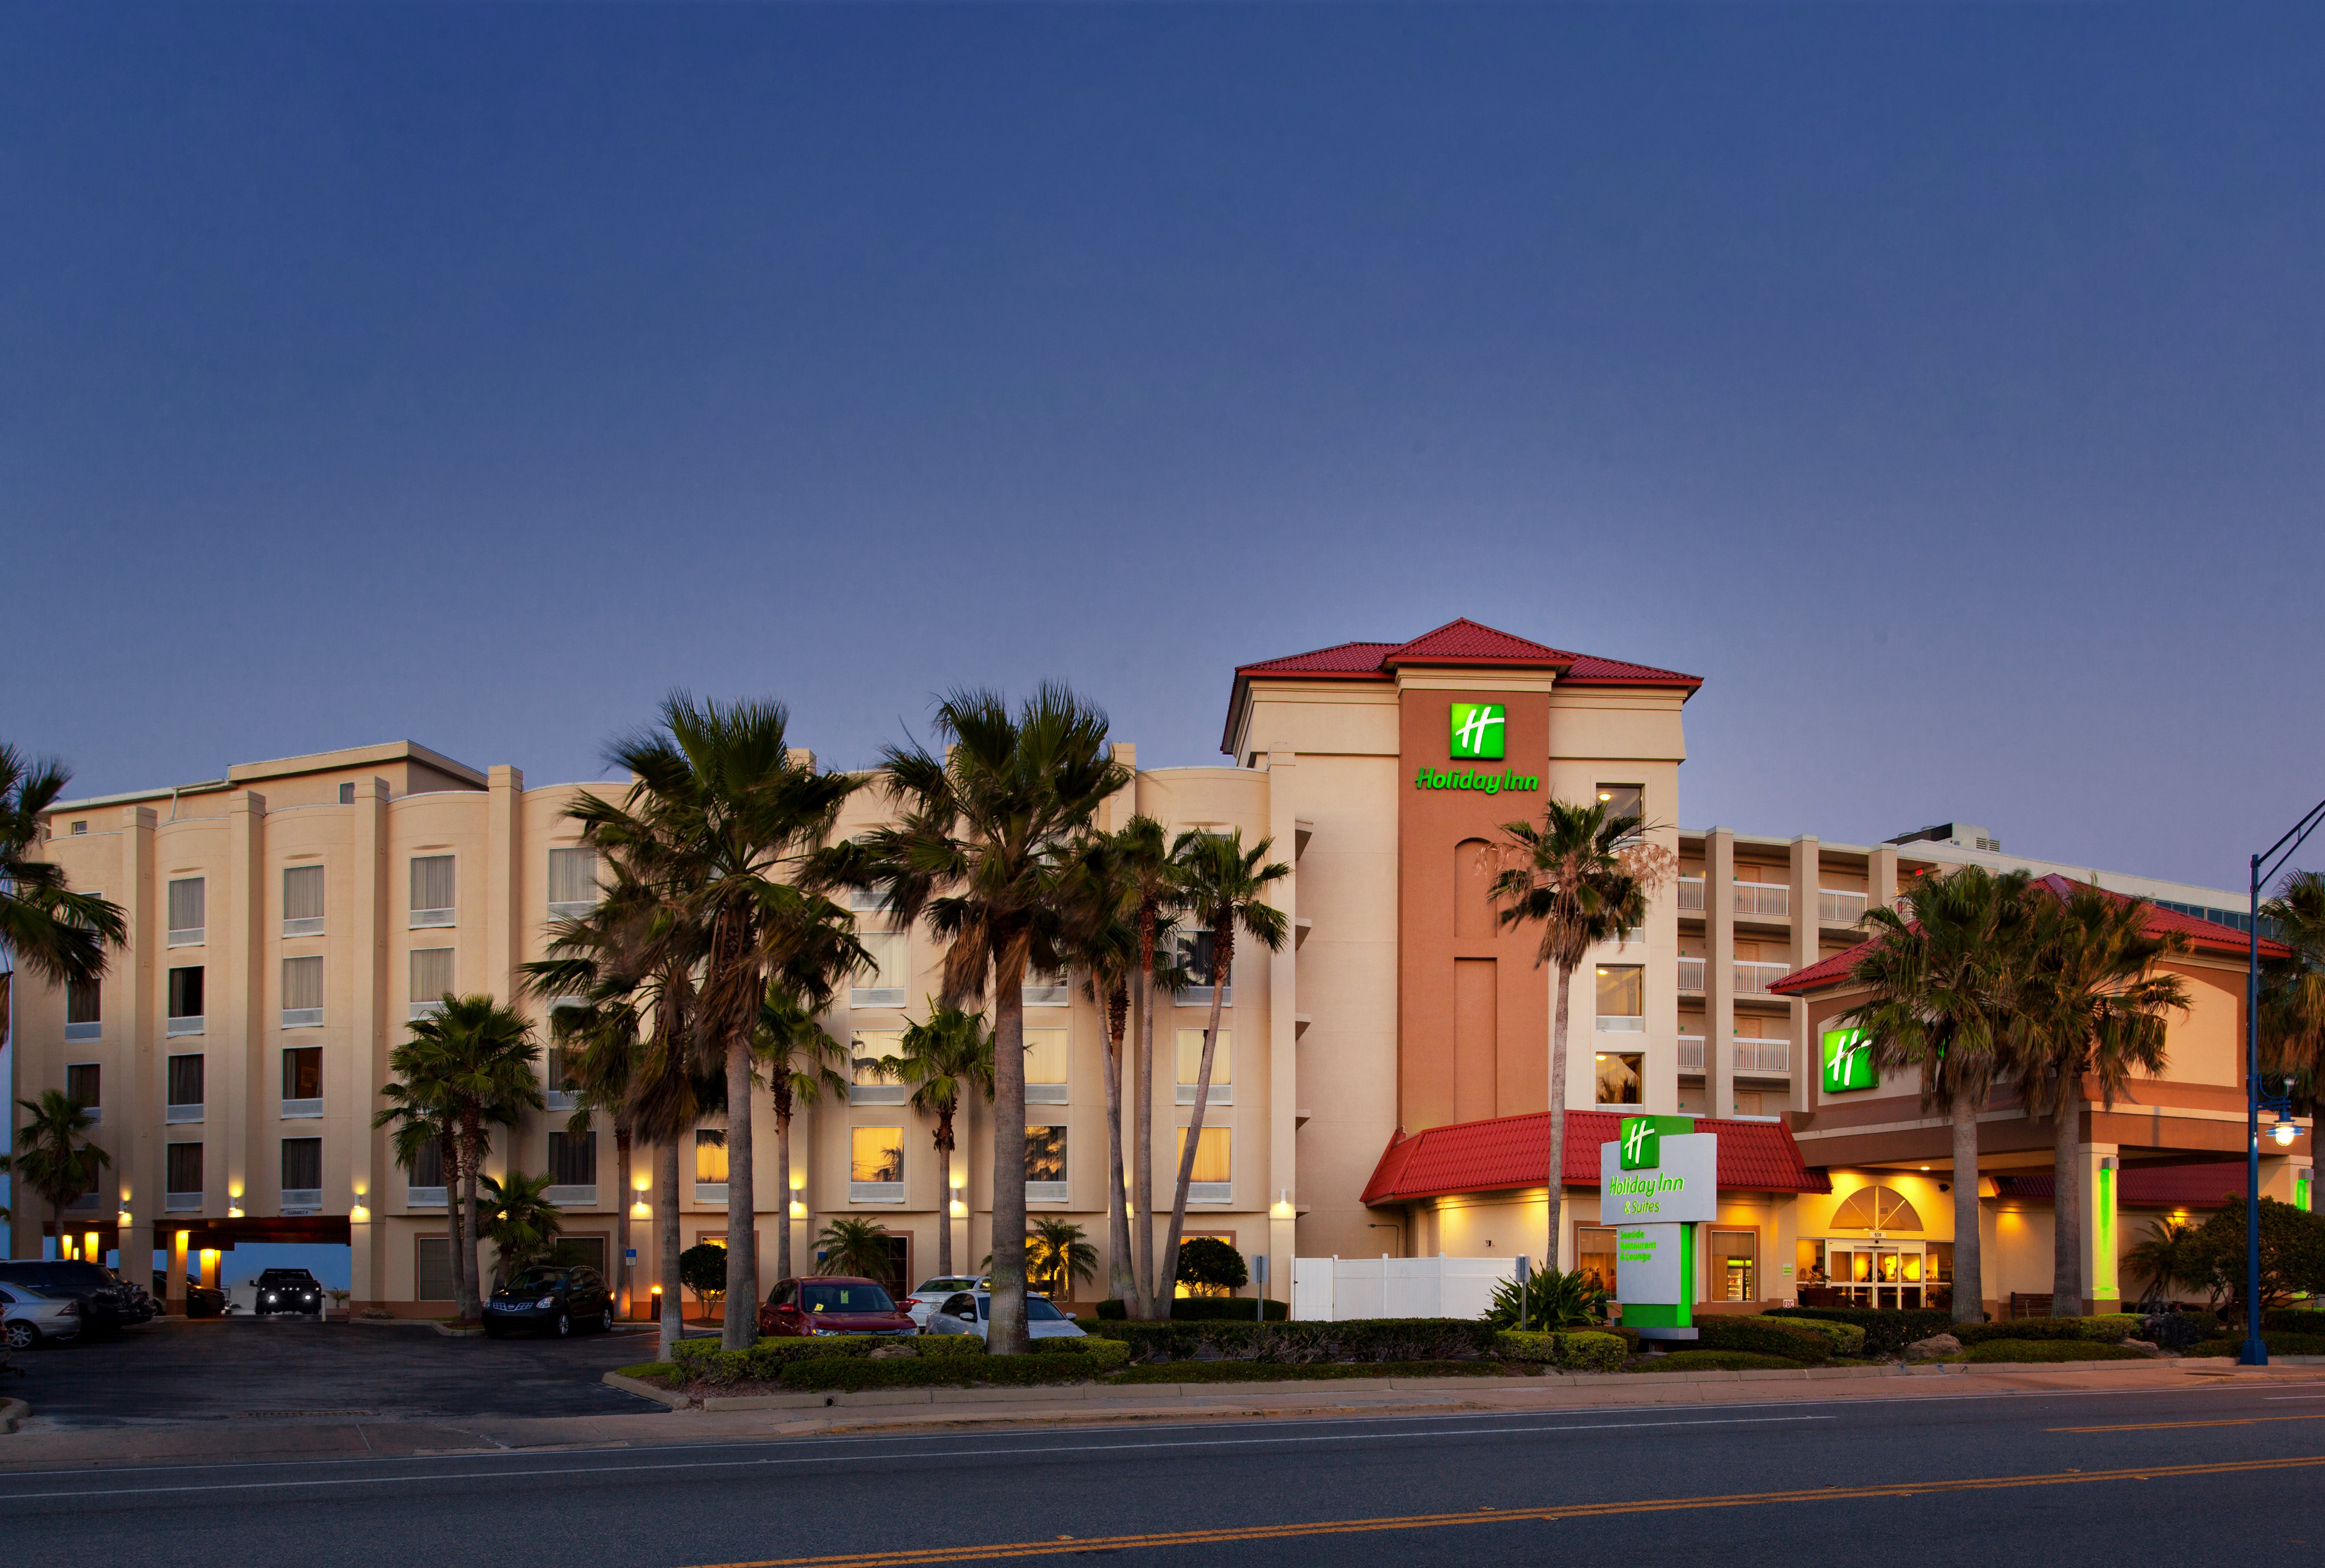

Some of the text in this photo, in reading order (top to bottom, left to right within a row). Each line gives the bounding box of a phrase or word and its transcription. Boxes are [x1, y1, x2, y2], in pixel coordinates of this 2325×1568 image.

[1415, 767, 1538, 794] Holiday Inn
[1609, 1172, 1684, 1198] Holiday Inn
[1624, 1200, 1661, 1214] & Suites
[1620, 1229, 1645, 1240] Seaside
[1620, 1241, 1657, 1250] Restaurant
[1625, 1252, 1651, 1263] Lounge
